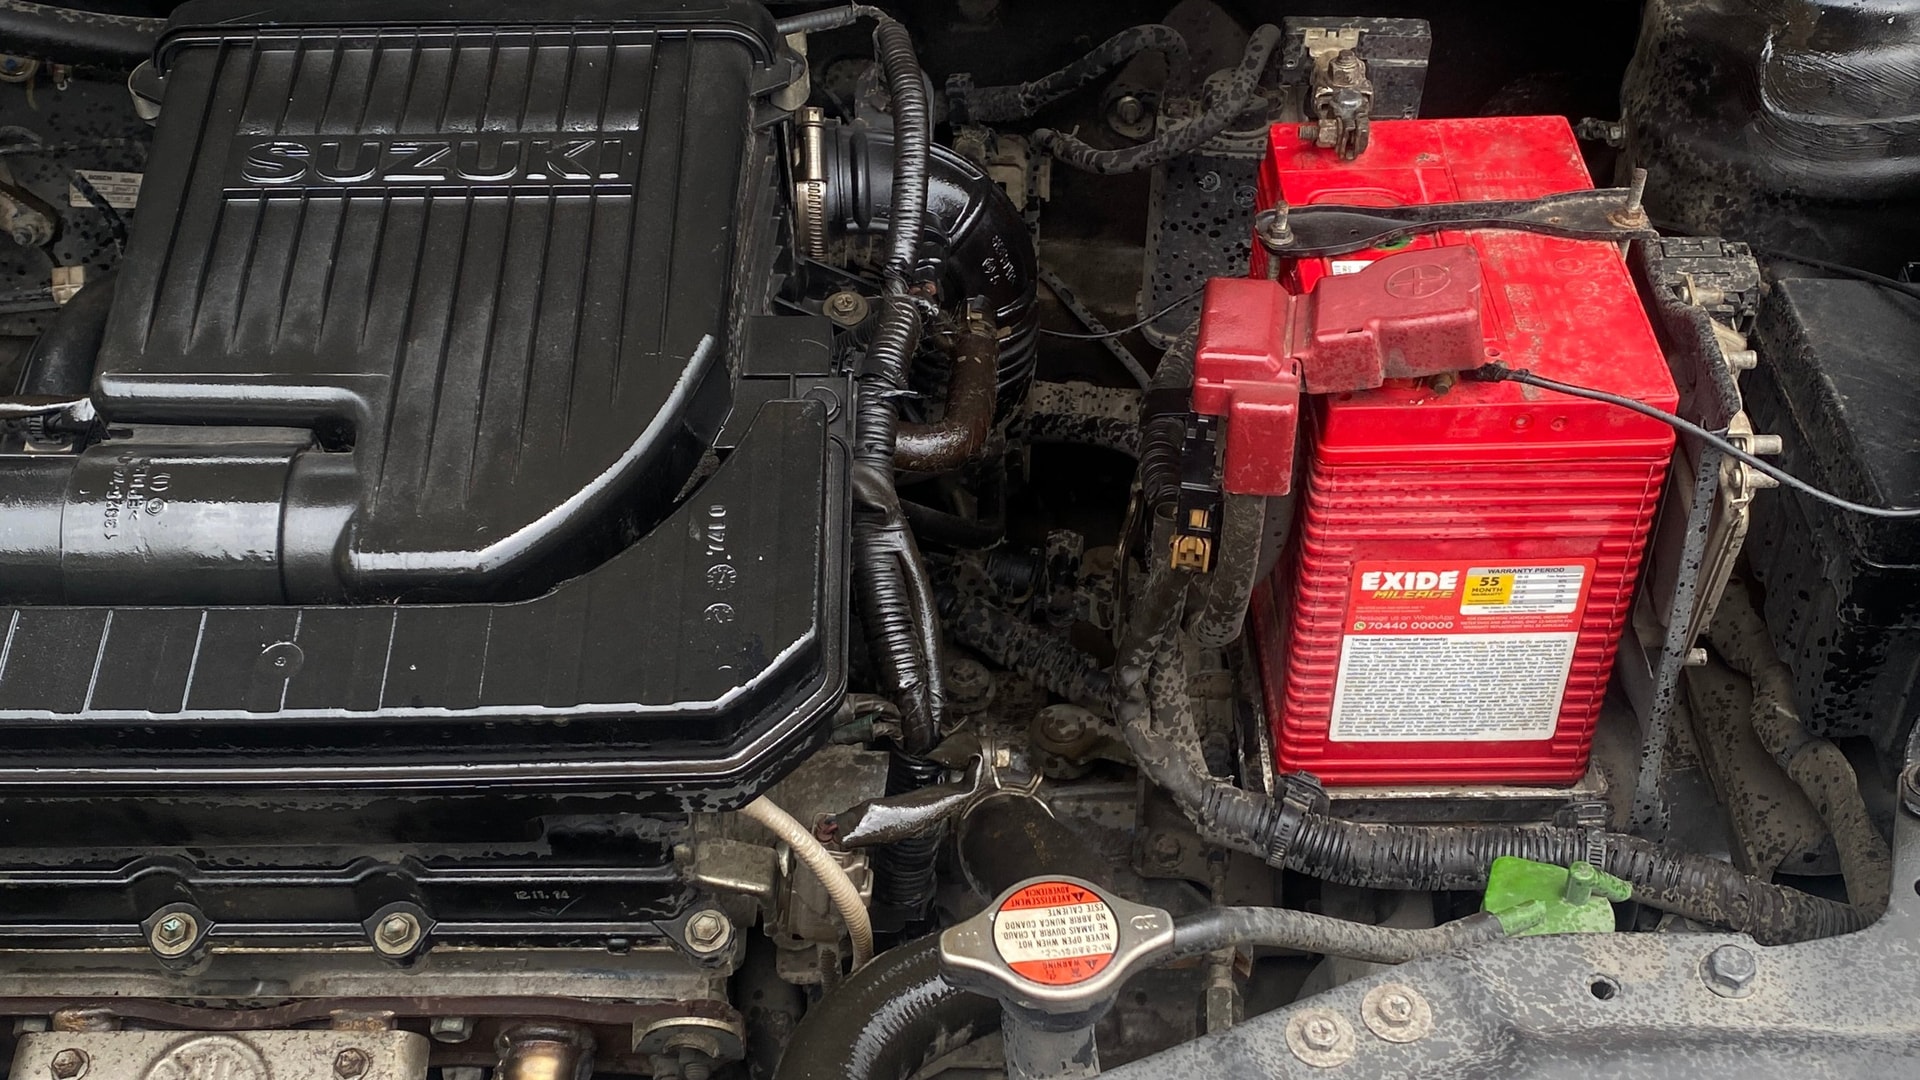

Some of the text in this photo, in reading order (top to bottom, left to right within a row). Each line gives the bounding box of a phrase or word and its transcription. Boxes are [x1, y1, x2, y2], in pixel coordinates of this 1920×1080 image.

[241, 139, 624, 184] SUZUKI
[1361, 570, 1459, 590] EXIDE
[1480, 576, 1500, 586] 55
[1372, 590, 1454, 599] MILEAGE
[1368, 621, 1454, 630] 70440 00000
[1011, 894, 1071, 907] AVERTISSEMENT
[1087, 904, 1104, 912] ESTE
[1005, 913, 1106, 930] NO ABRIR NUNCA CUANDO
[1040, 927, 1066, 937] OUVRIR
[1070, 924, 1095, 932] JAMAIS
[1063, 935, 1082, 943] OPEN
[1085, 933, 1110, 941] NEVER
[1036, 938, 1059, 947] WHEN
[1042, 959, 1081, 969] WARNING
